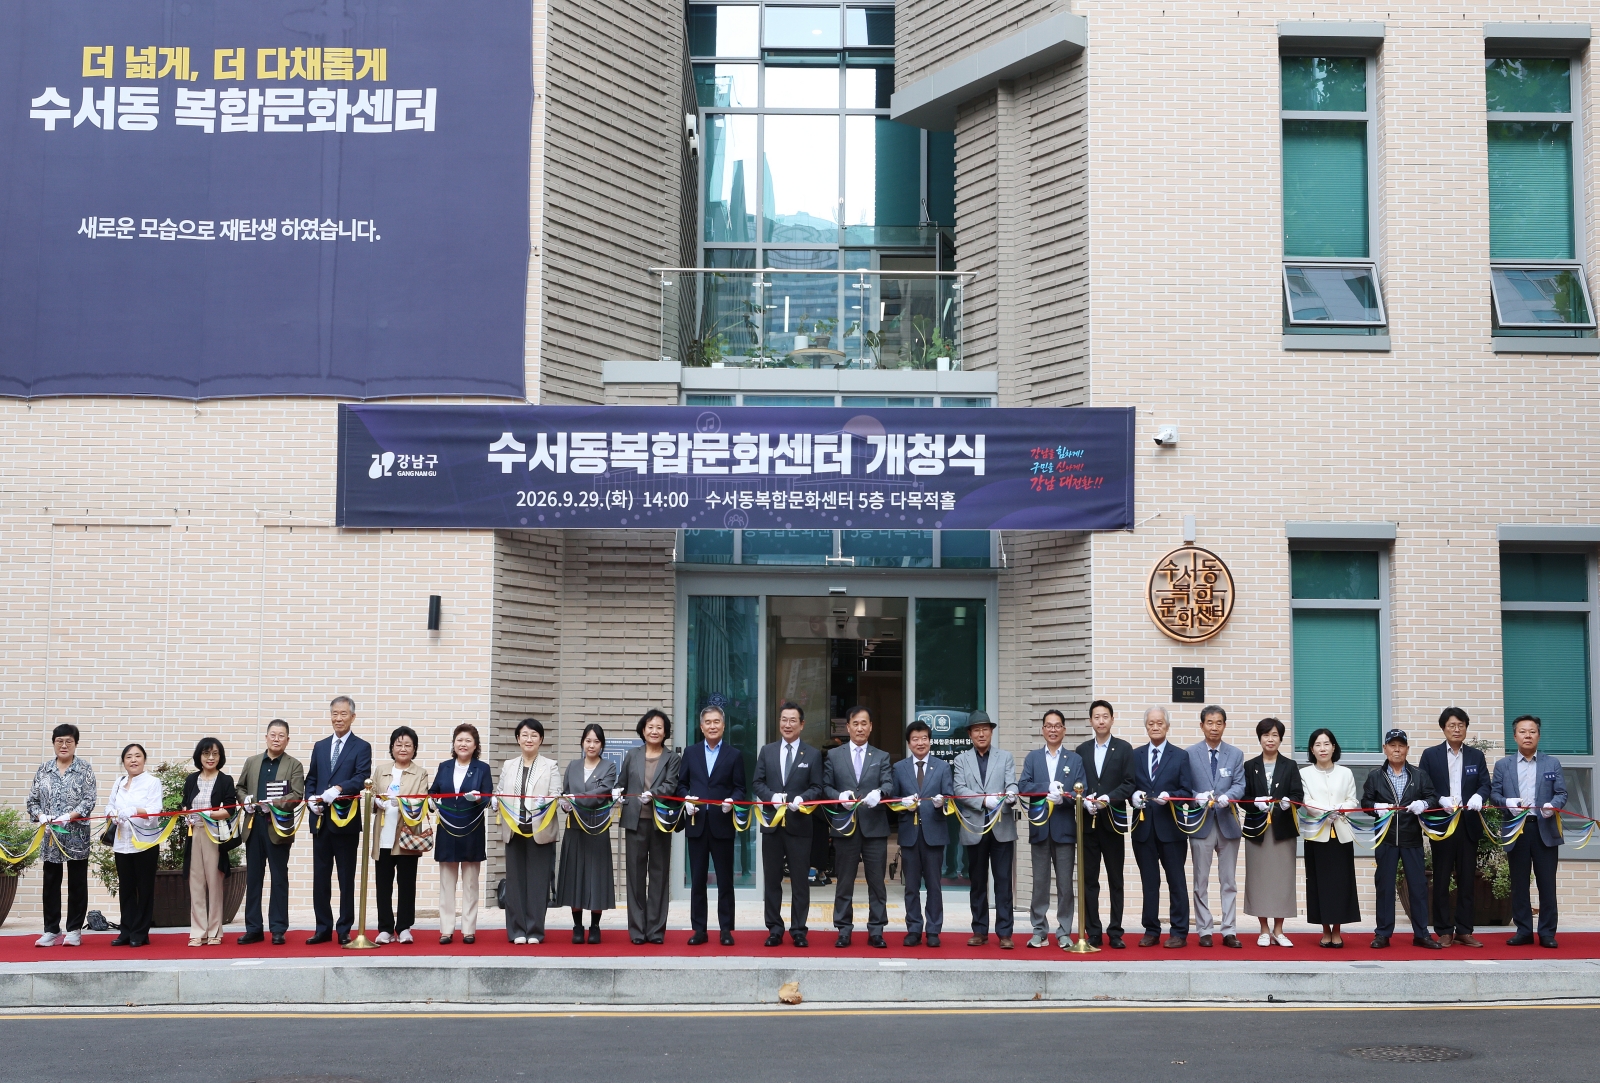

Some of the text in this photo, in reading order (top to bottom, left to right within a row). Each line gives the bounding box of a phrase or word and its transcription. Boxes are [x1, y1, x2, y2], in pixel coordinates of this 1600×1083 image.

[81, 46, 387, 82] 더 넓게, 더 다채롭게
[29, 86, 437, 133] 수서동 복합문화센터
[77, 217, 381, 242] 새로운 모습으로 재탄생 하였습니다.
[397, 454, 438, 469] 강남구
[487, 432, 986, 475] 수서동복합문화센터 개청식
[1030, 447, 1055, 459] 강남을
[1030, 462, 1054, 474] 구민을
[1030, 474, 1104, 492] 강남 대전환!!
[516, 490, 956, 511] 2026.9.29.(화) 14:00 수서동복합문화센터 5층 다목적홀
[1157, 553, 1222, 584] 수서동
[1176, 675, 1200, 685] 301-4
